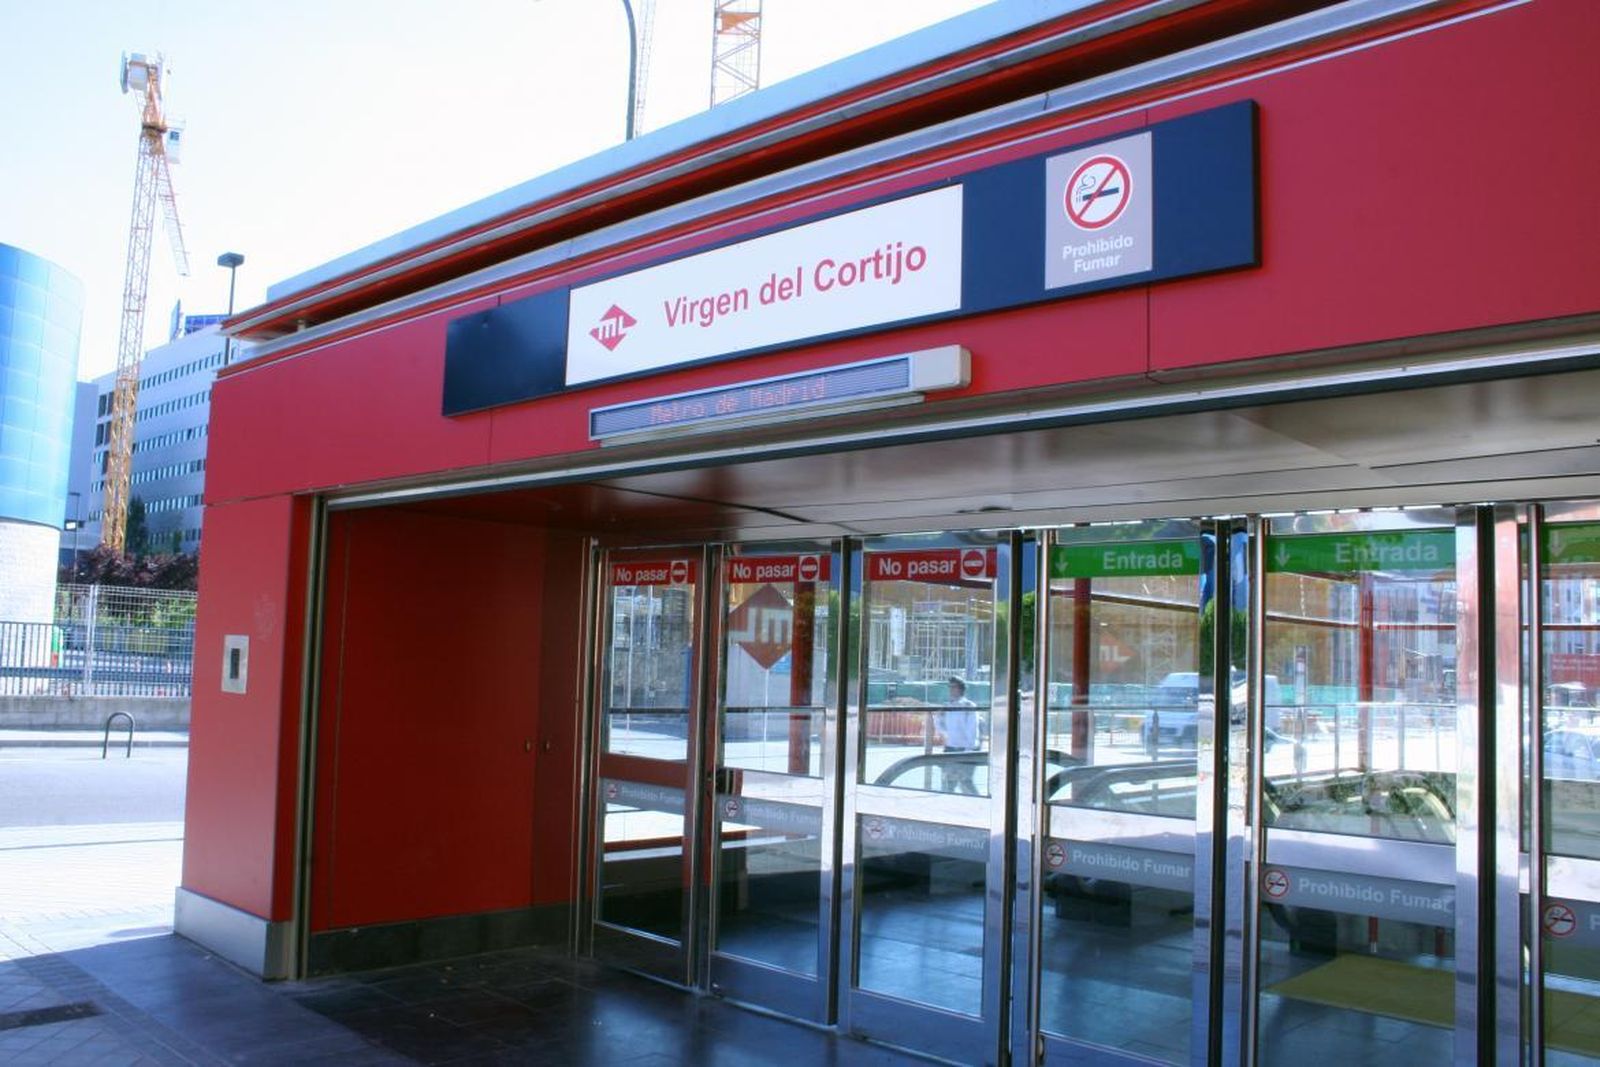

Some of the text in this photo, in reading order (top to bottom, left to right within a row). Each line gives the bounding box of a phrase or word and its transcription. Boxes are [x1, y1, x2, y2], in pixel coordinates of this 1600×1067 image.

[1062, 235, 1134, 260] Prohibido
[1074, 255, 1121, 273] Fumar
[664, 242, 927, 327] Virgen del Cortijo
[1103, 550, 1183, 570] Entrada
[1335, 541, 1439, 564] Entrada
[616, 567, 668, 585] No pasar
[733, 563, 796, 581] No pasar
[879, 558, 957, 578] No pasar
[1073, 850, 1191, 878] Prohibido Fumar
[1299, 878, 1453, 911] Prohibido Fumar
